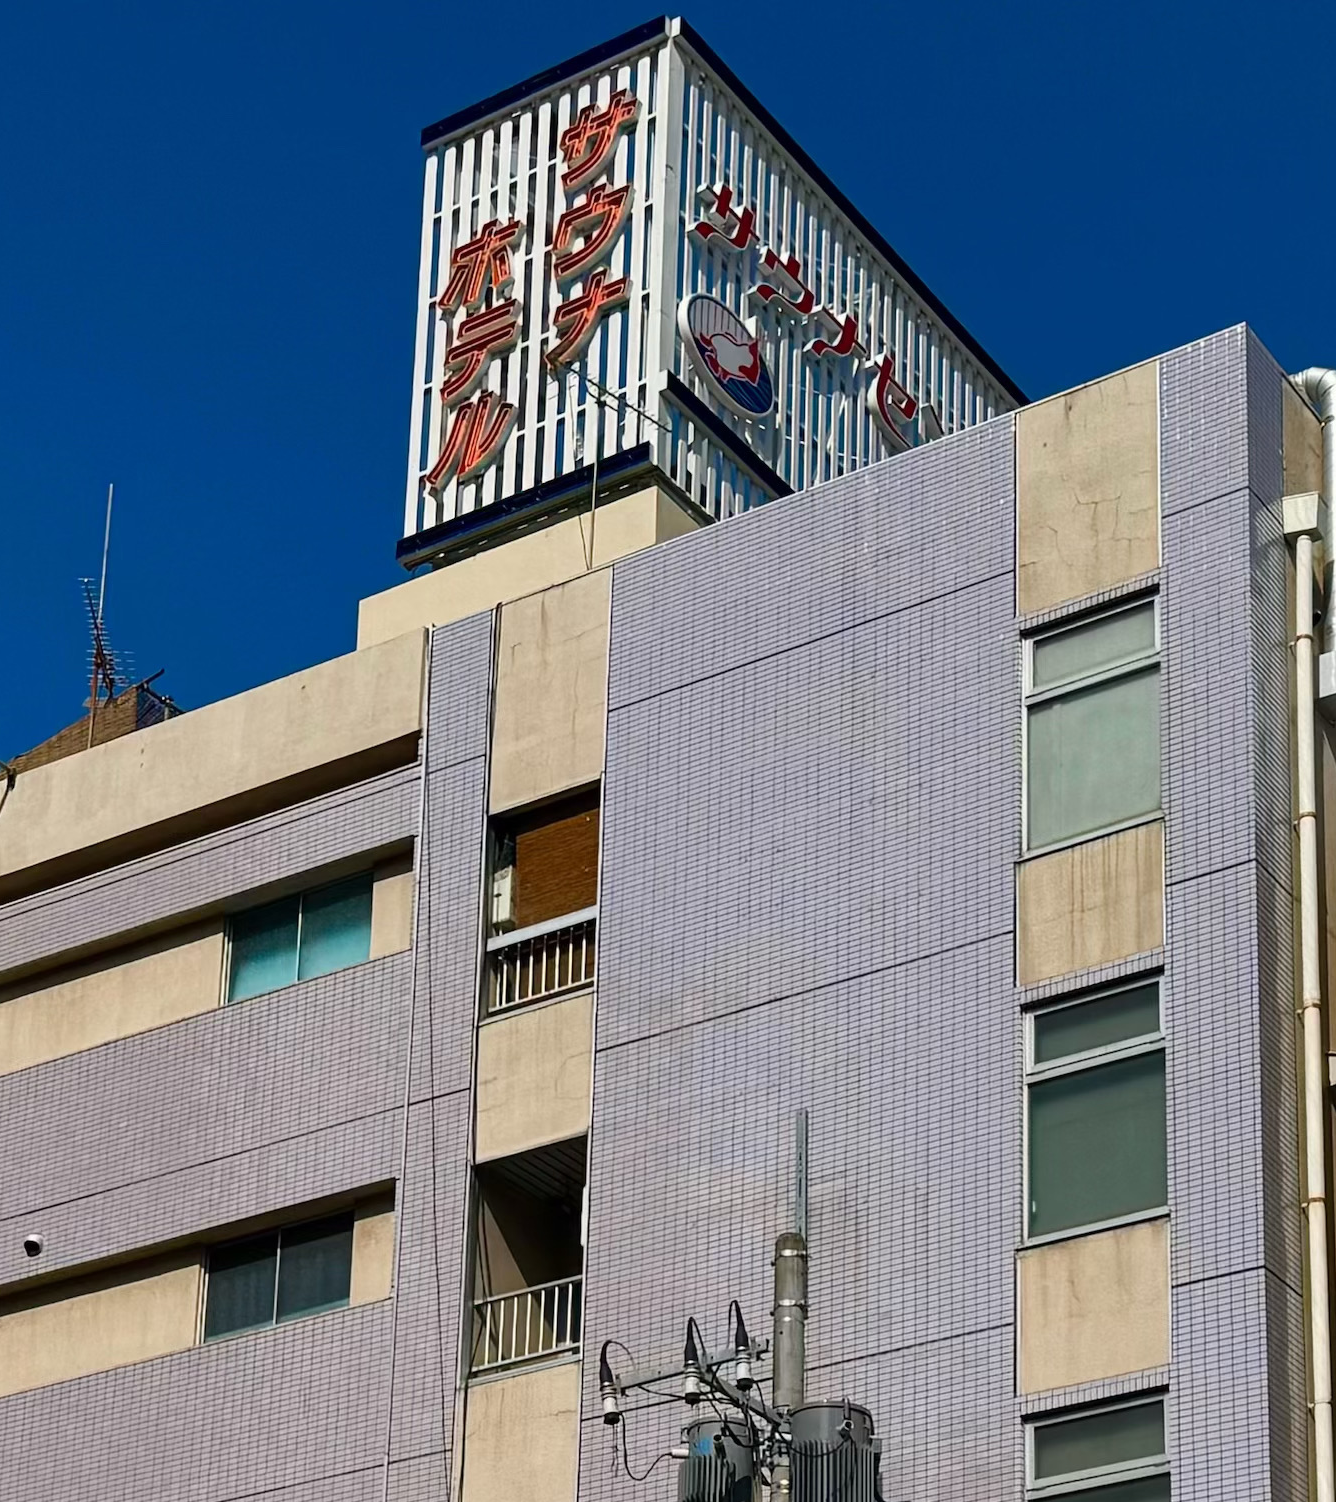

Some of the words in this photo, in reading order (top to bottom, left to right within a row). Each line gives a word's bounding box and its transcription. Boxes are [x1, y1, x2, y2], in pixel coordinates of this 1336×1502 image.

[426, 218, 525, 488] ホテル
[545, 88, 642, 369] サウナ
[687, 182, 947, 450] サウナセ
